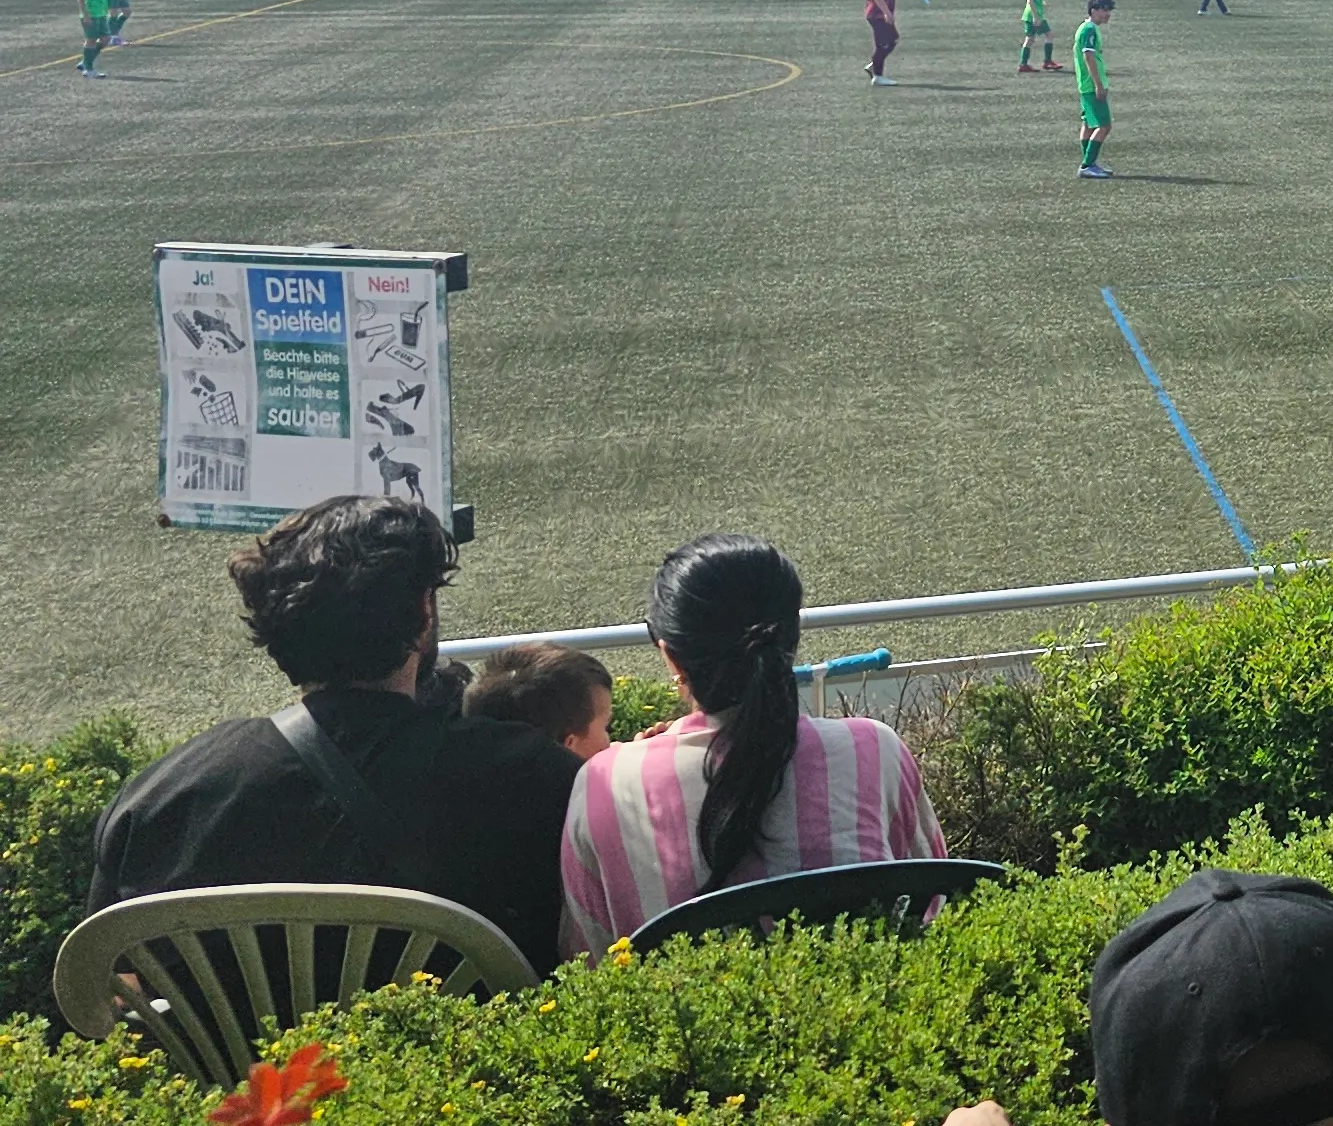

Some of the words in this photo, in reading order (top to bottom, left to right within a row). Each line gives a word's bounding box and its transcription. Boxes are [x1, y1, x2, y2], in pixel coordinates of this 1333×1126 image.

[192, 270, 215, 287] Ja!
[367, 276, 410, 293] Nein!
[265, 277, 327, 305] DEIN
[254, 309, 342, 336] Spielfeld
[263, 348, 311, 364] Beachte
[313, 349, 341, 365] bitte
[265, 367, 283, 380] die
[286, 368, 341, 384] Hinweise
[268, 384, 291, 398] und
[293, 385, 323, 400] halte
[325, 388, 339, 401] es
[267, 404, 341, 429] sauber
